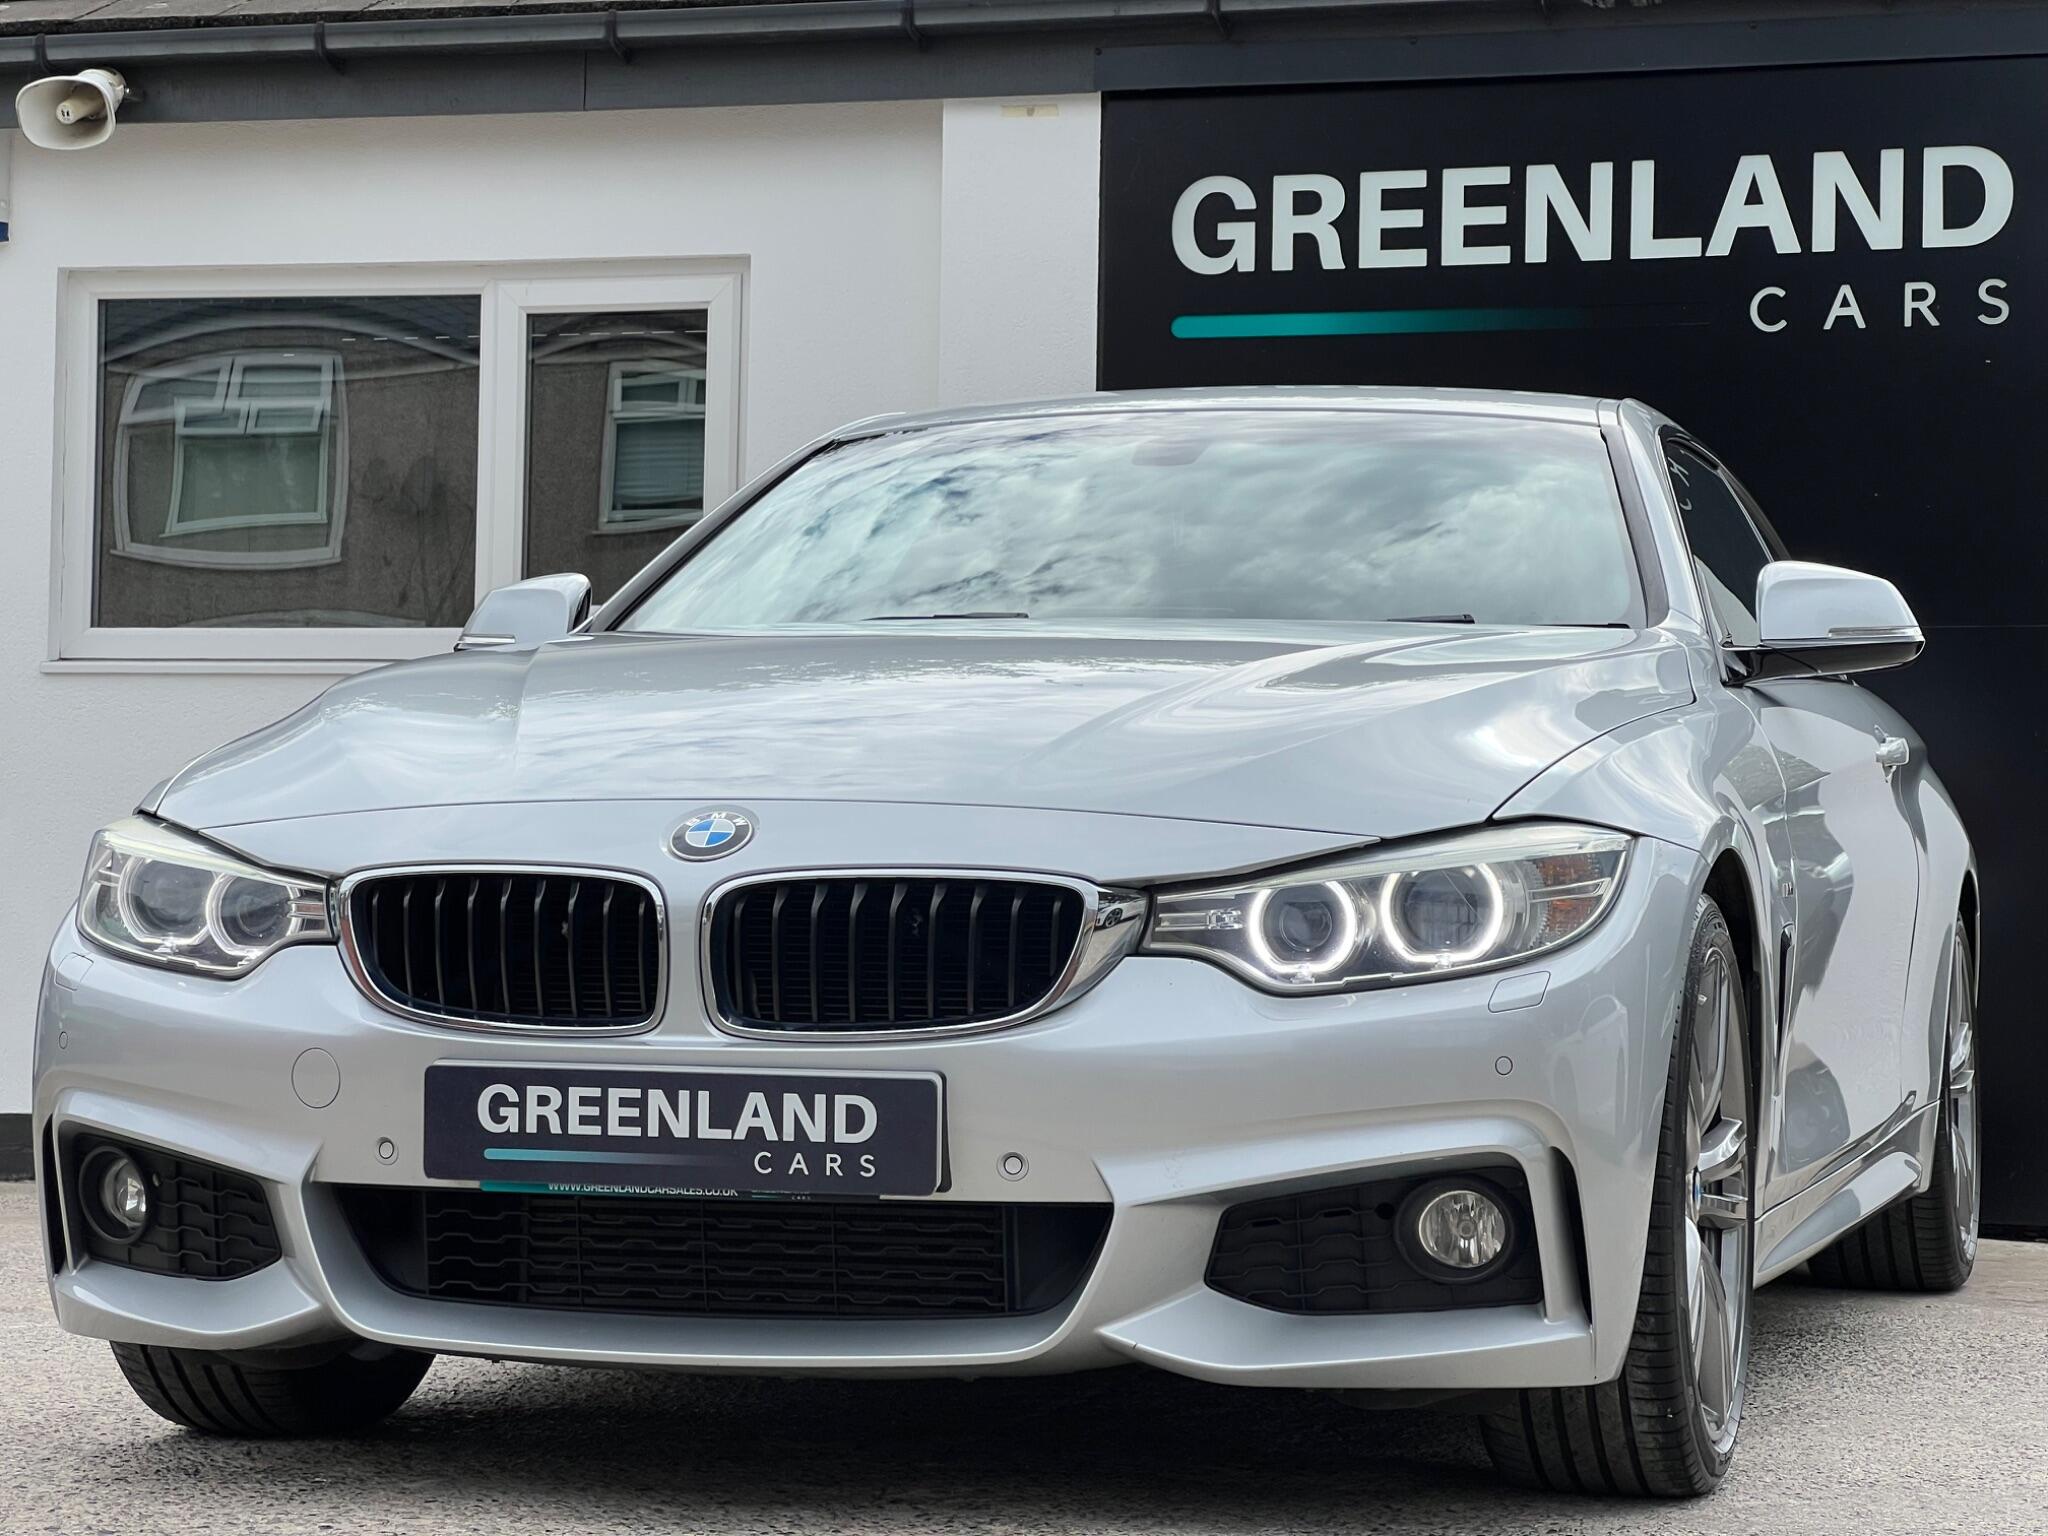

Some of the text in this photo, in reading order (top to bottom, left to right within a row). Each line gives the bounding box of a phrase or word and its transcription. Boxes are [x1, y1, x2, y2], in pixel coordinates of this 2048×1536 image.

[1171, 145, 2014, 275] GREENLAND
[1749, 278, 2011, 333] CARS
[686, 811, 748, 826] BMW
[477, 1083, 878, 1144] GREENLAND
[753, 1151, 877, 1178] CARS
